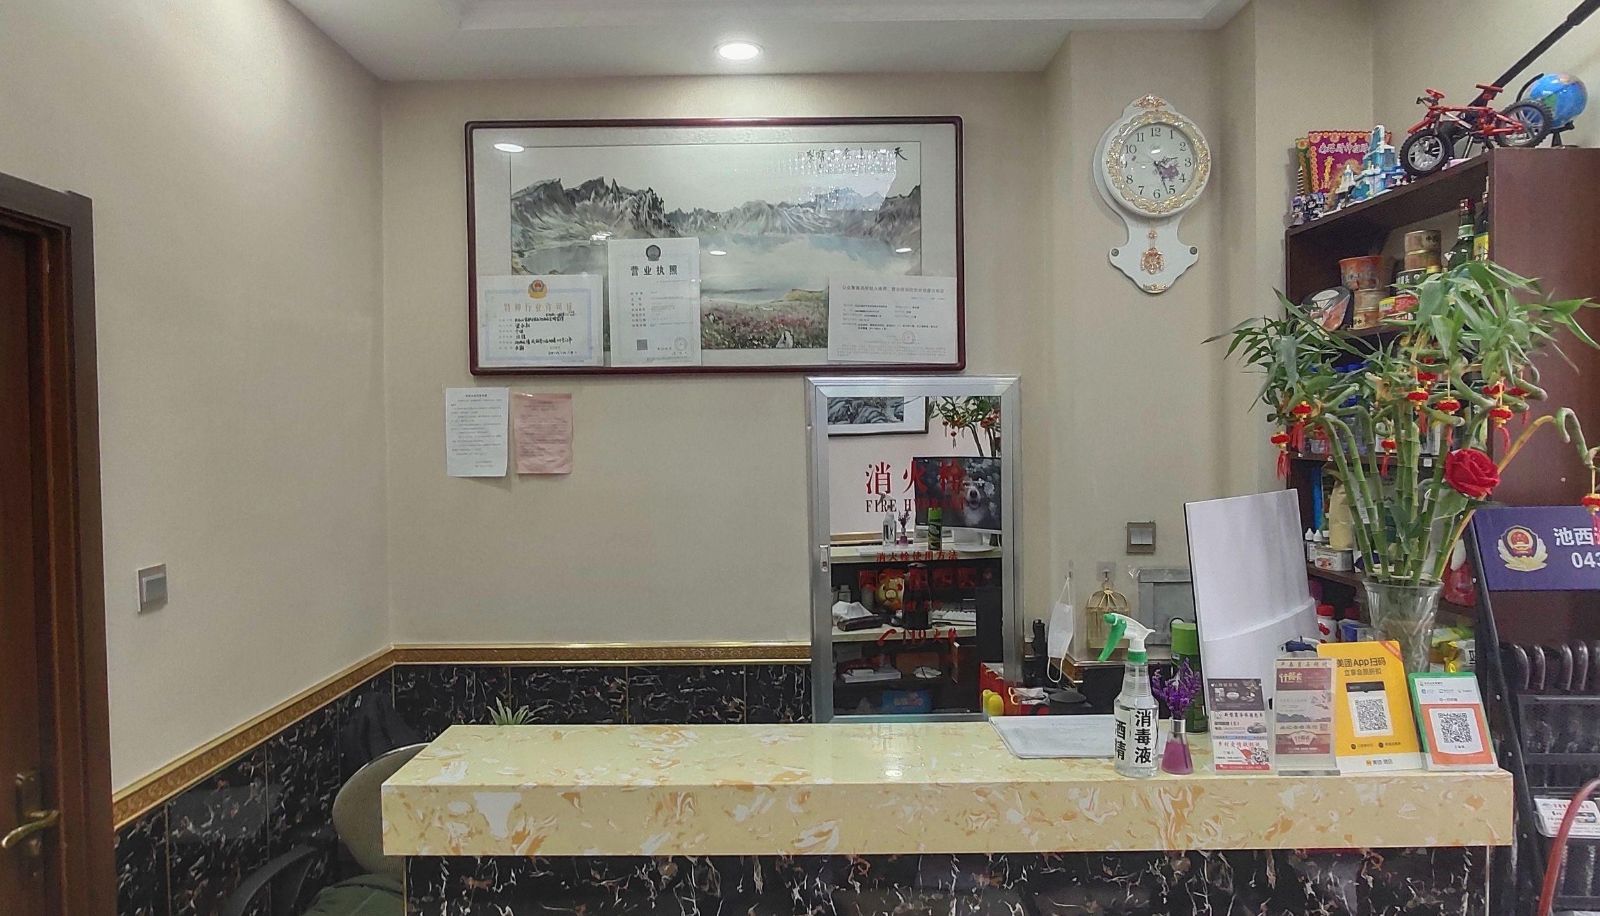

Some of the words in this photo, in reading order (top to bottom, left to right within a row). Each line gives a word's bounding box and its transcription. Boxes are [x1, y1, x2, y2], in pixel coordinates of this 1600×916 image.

[1136, 132, 1144, 142] 11
[1150, 127, 1161, 137] 12
[1169, 129, 1174, 139] 1
[1125, 144, 1137, 154] 10
[1179, 141, 1187, 152] 2
[1184, 157, 1192, 167] 3
[1126, 174, 1134, 184] 8
[1178, 172, 1186, 183] 4
[1138, 185, 1145, 195] 7
[1153, 188, 1161, 199] 6
[1168, 184, 1176, 194] 5
[630, 264, 678, 277] 营业执照
[866, 499, 897, 512] FIRE
[1134, 710, 1151, 763] 消毒液
